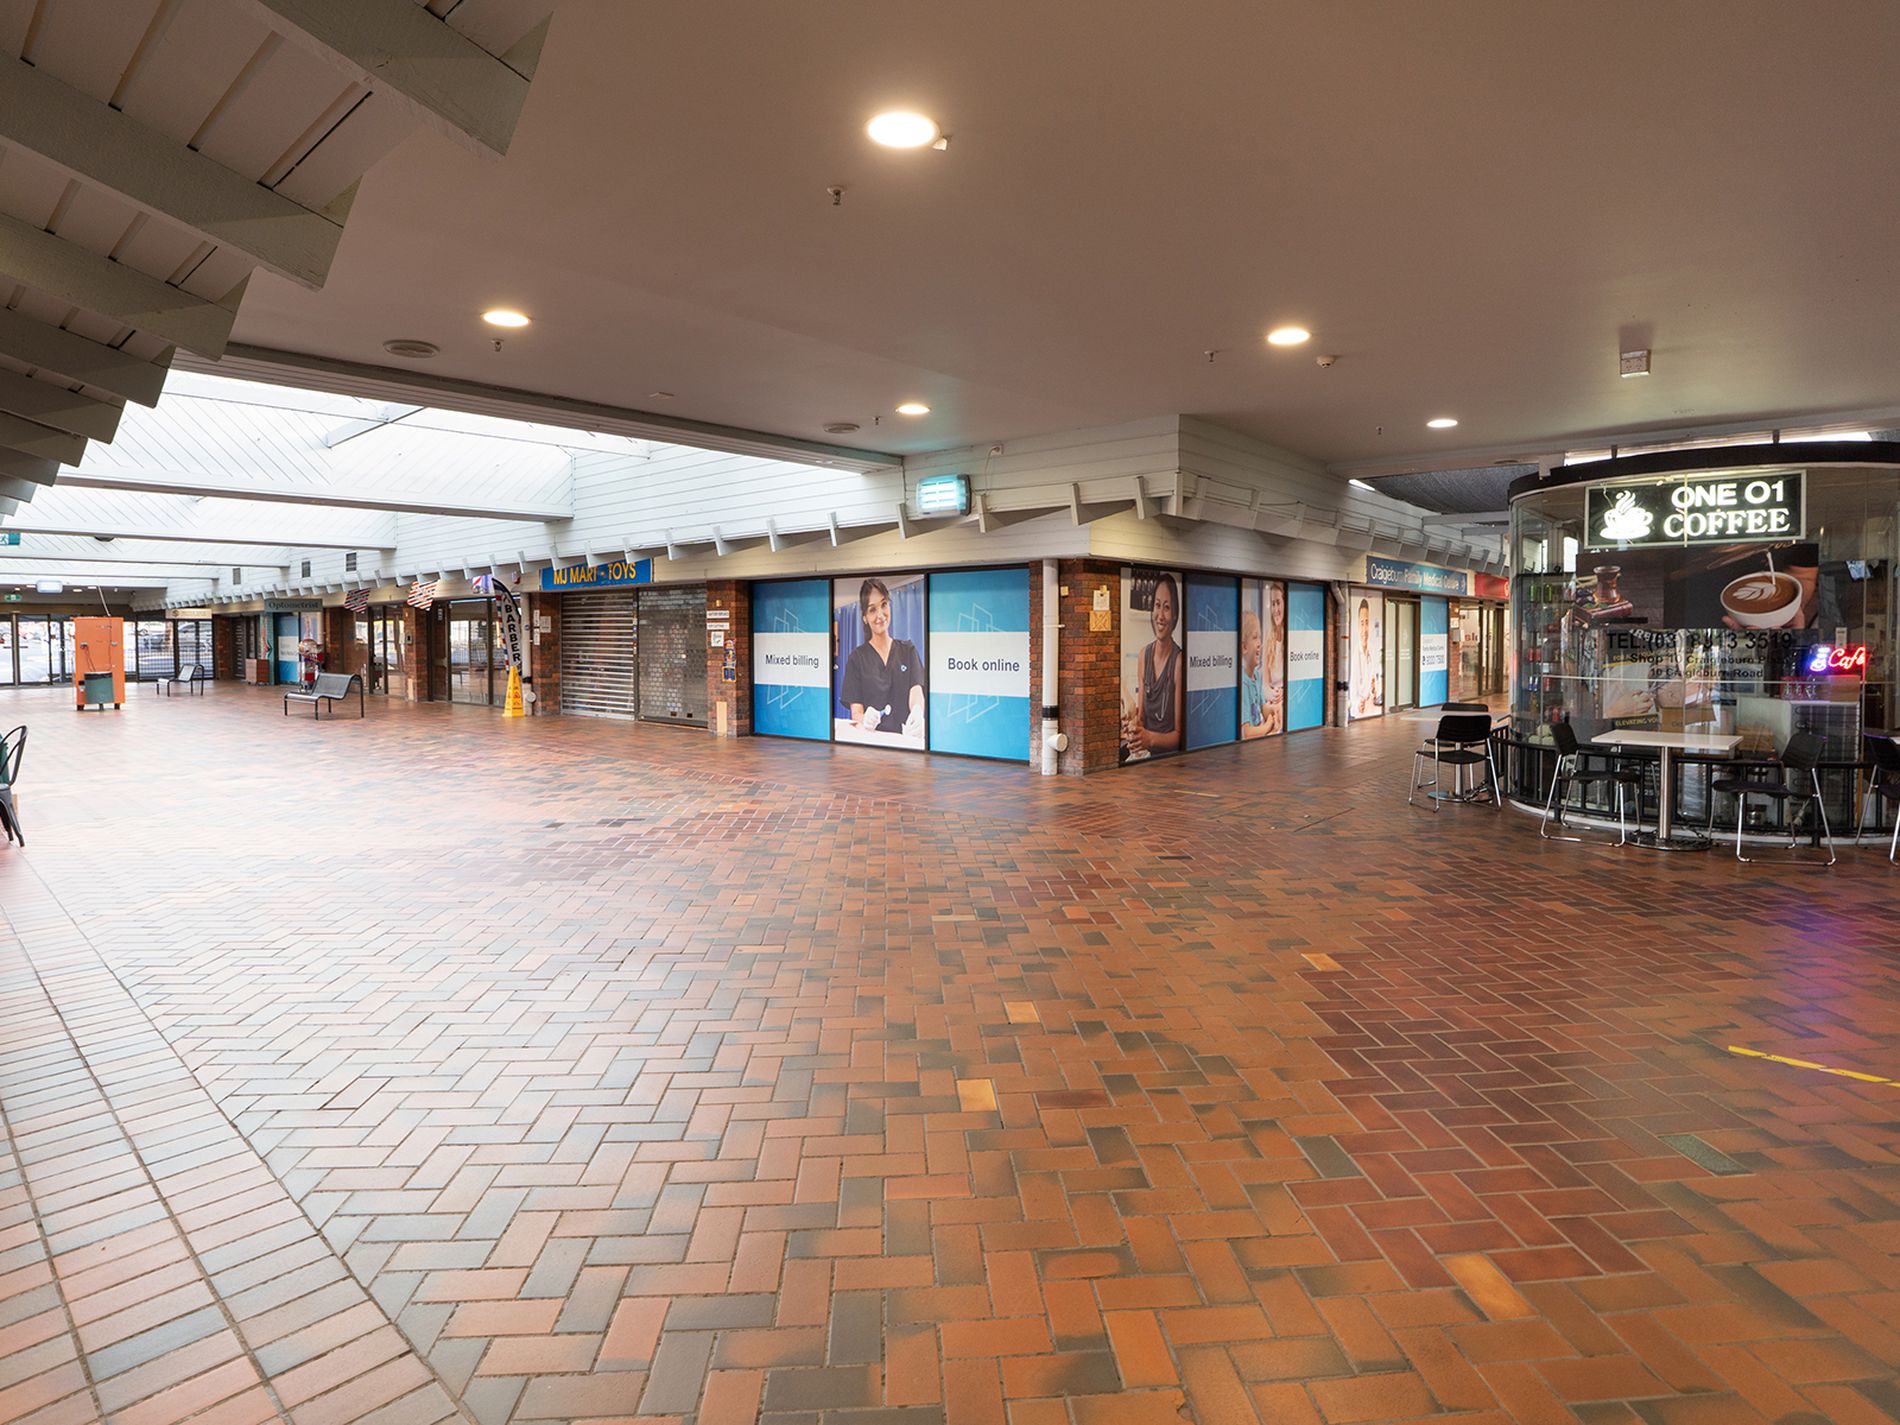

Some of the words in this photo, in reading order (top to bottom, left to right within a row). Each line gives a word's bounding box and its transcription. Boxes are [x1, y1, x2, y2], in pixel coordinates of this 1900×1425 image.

[1671, 483, 1737, 508] ONE
[1663, 508, 1790, 538] COFFEE
[553, 569, 568, 584] MJ
[570, 566, 597, 583] MART
[607, 561, 637, 580] TOYS
[268, 601, 318, 610] Optometrist
[504, 604, 521, 662] BARBER
[1745, 632, 1792, 649] 3519
[765, 654, 791, 666] Mixed
[792, 655, 819, 668] billing
[1189, 656, 1211, 668] Mixed
[1212, 654, 1232, 668] billing
[1290, 651, 1304, 661] Book
[1305, 651, 1319, 660] online
[1631, 653, 1663, 664] Shop
[948, 657, 978, 671] Book
[982, 658, 1020, 671] online
[1733, 669, 1763, 678] Road
